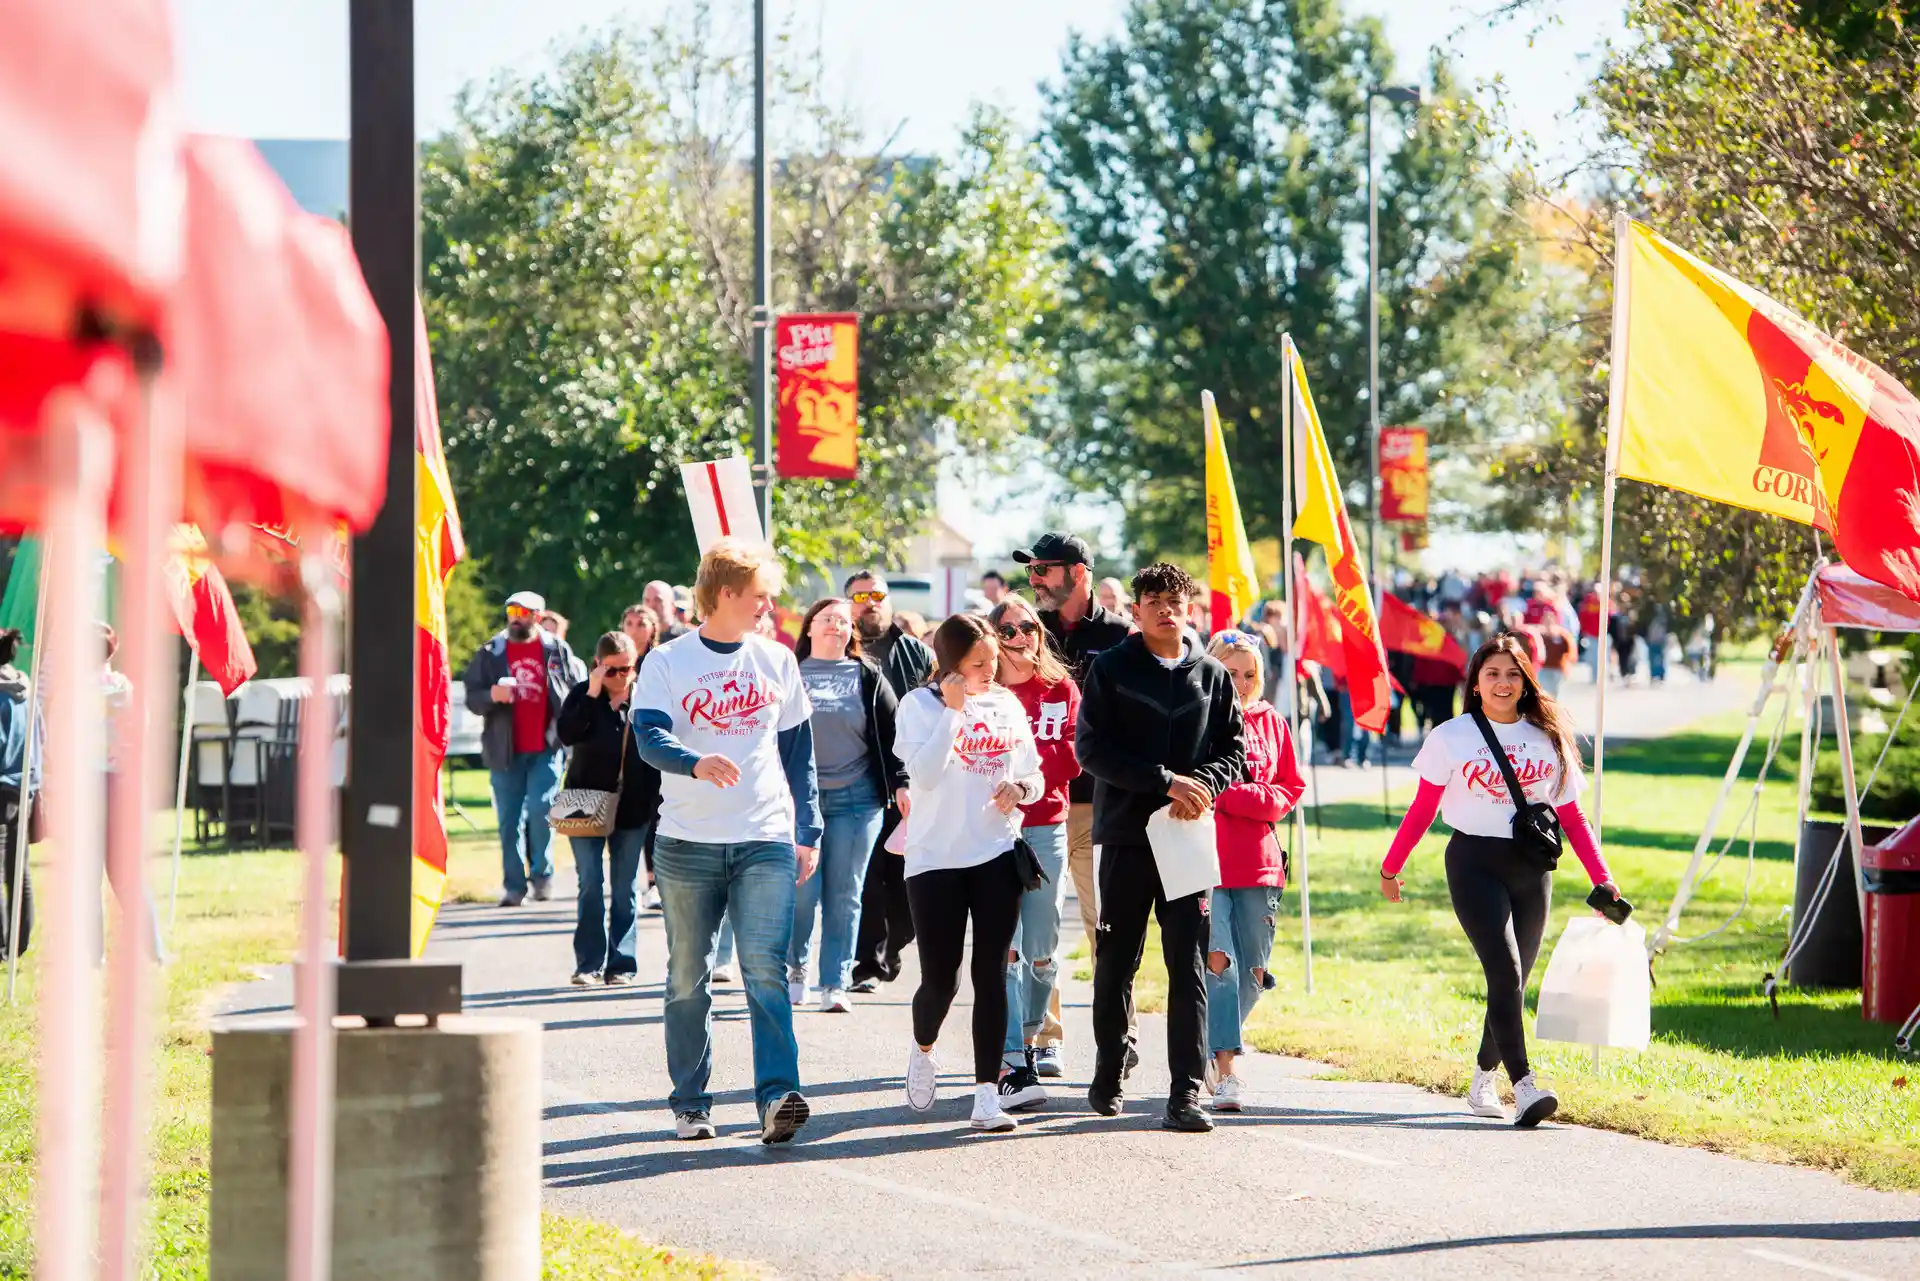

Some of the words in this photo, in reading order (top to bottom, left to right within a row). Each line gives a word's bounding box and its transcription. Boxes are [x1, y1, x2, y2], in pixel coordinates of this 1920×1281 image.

[786, 322, 832, 347] Pitt
[780, 344, 836, 370] State
[682, 680, 777, 726] Rumble
